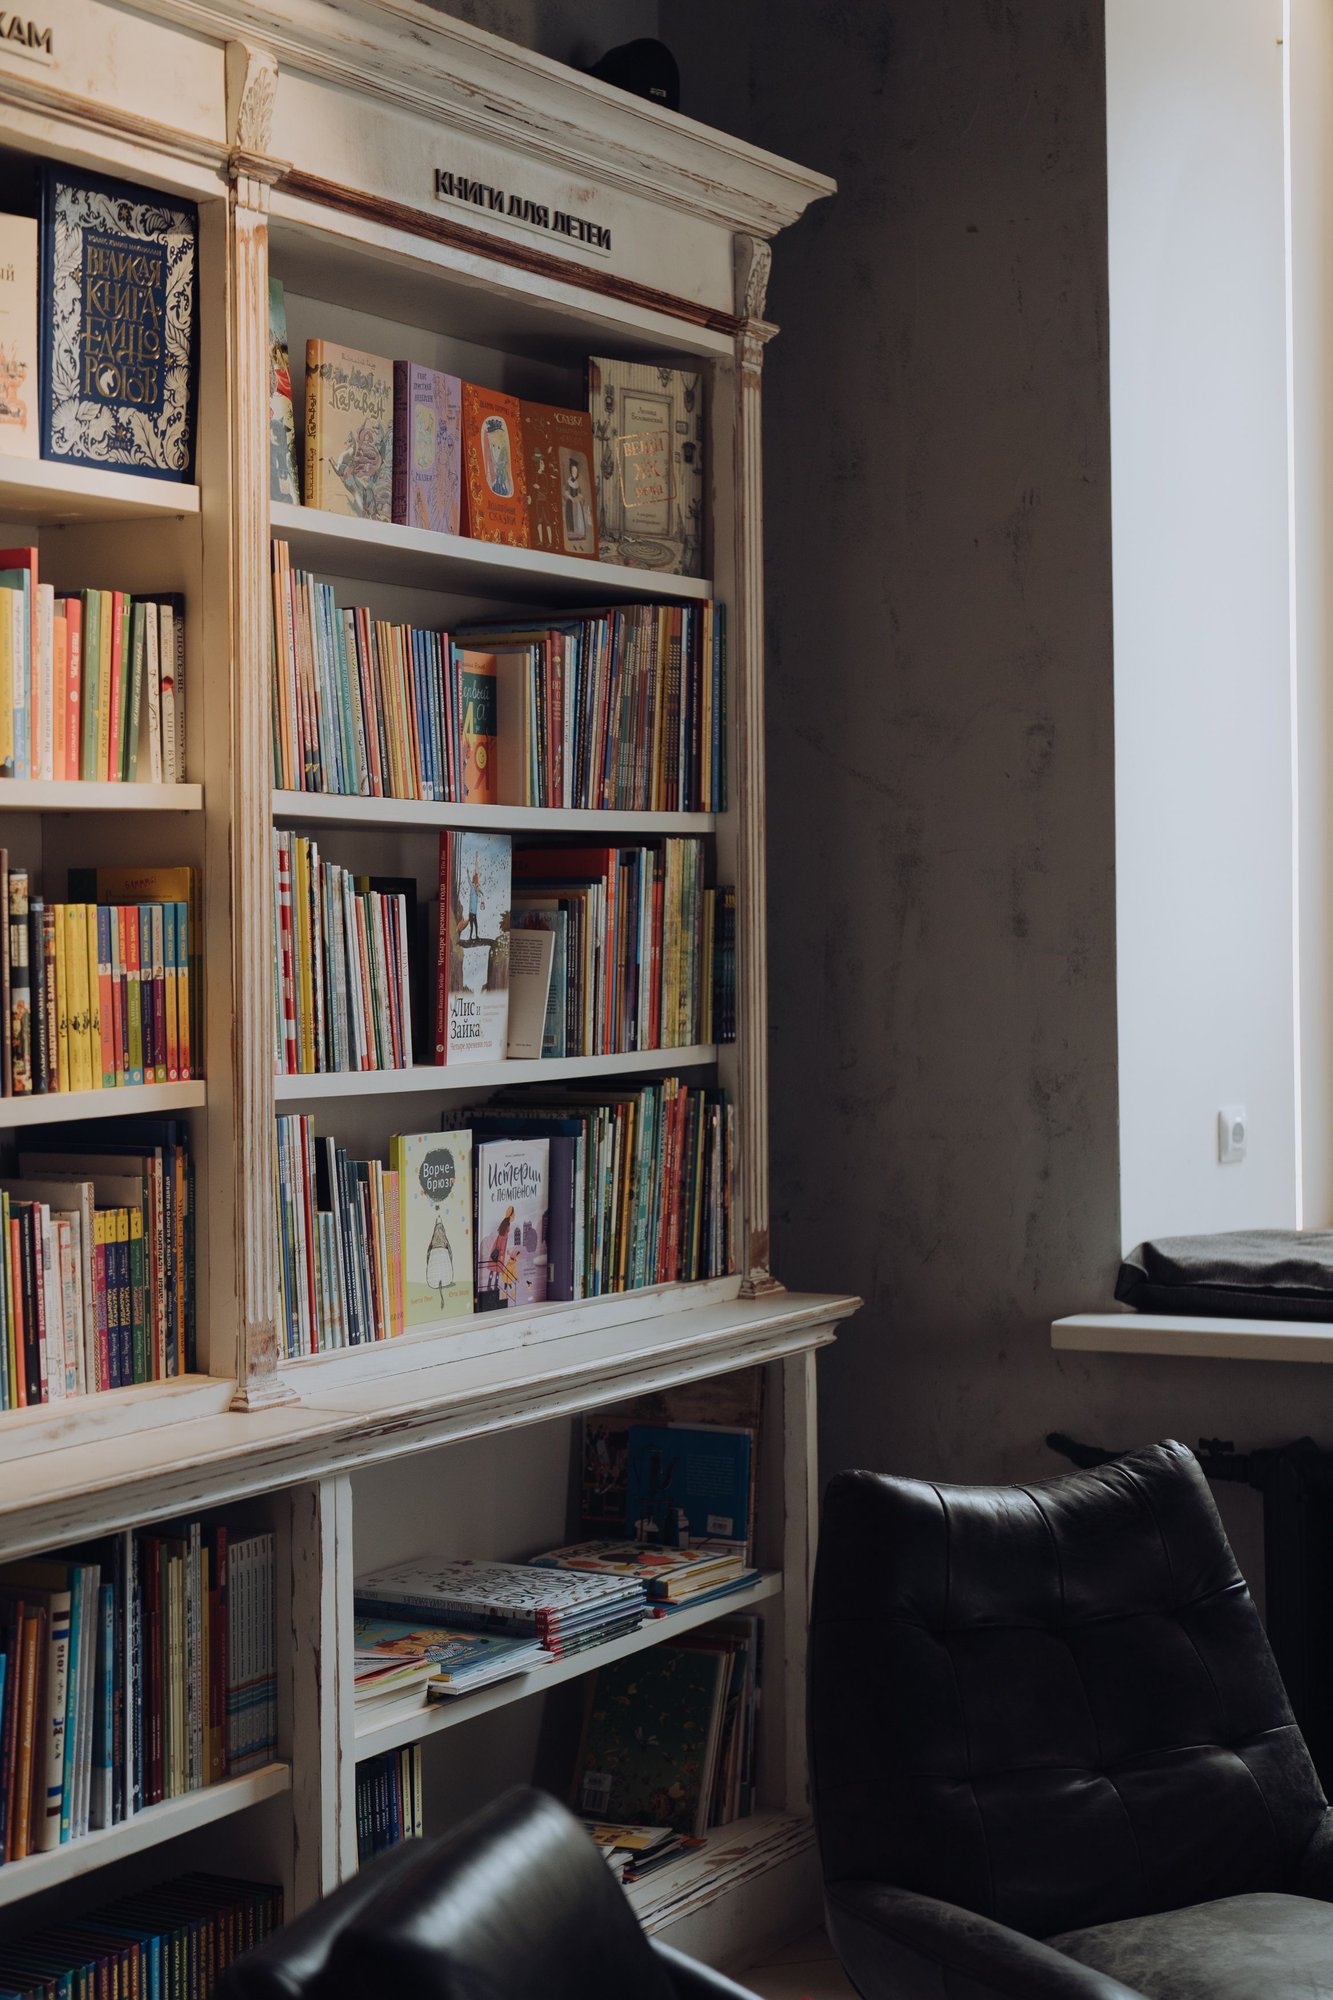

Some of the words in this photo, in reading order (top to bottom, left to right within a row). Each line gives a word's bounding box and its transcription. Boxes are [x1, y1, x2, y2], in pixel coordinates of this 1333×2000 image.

[434, 168, 505, 213] КНИГИ
[507, 194, 550, 230] ДЛЯ
[86, 245, 162, 289] ВЕЛИКАЯ
[86, 277, 162, 331] КНИГА
[84, 354, 158, 404] РОГОВ
[176, 616, 184, 694] ЗВЕЗДОПАД
[462, 680, 490, 705] ервый
[438, 937, 446, 965] Четыре
[451, 997, 476, 1018] Лис
[450, 1018, 481, 1040] Зайка
[423, 1162, 454, 1179] Ворче-
[488, 1161, 541, 1190] Истории
[57, 1645, 65, 1676] 2018
